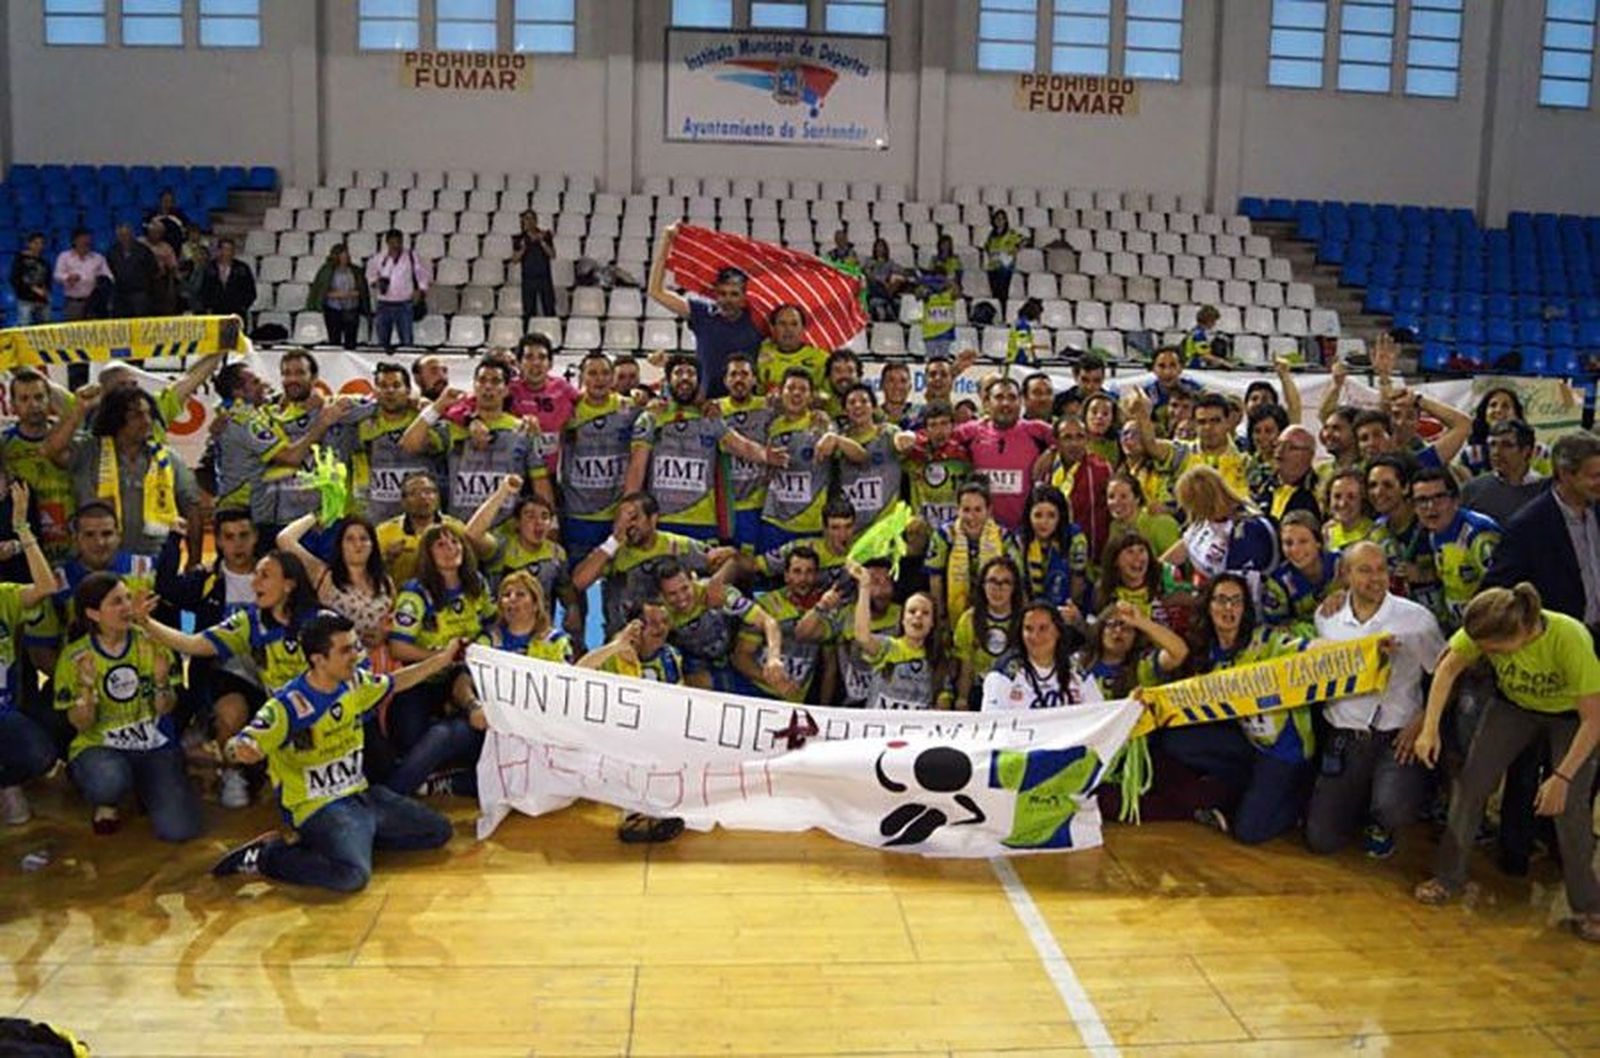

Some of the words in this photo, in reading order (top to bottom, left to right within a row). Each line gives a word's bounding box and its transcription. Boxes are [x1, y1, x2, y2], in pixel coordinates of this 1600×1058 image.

[404, 51, 526, 70] PROHIBIDO
[685, 45, 734, 71] Instituto
[738, 39, 795, 56] Municipal
[800, 41, 815, 57] de
[820, 44, 870, 77] Deportes
[415, 68, 516, 90] FUMAR
[1021, 74, 1134, 94] PROHIBIDO
[1029, 91, 1125, 115] FUMAR
[683, 117, 775, 139] Ayuntamiento
[780, 123, 795, 138] de
[802, 123, 869, 139] Santander
